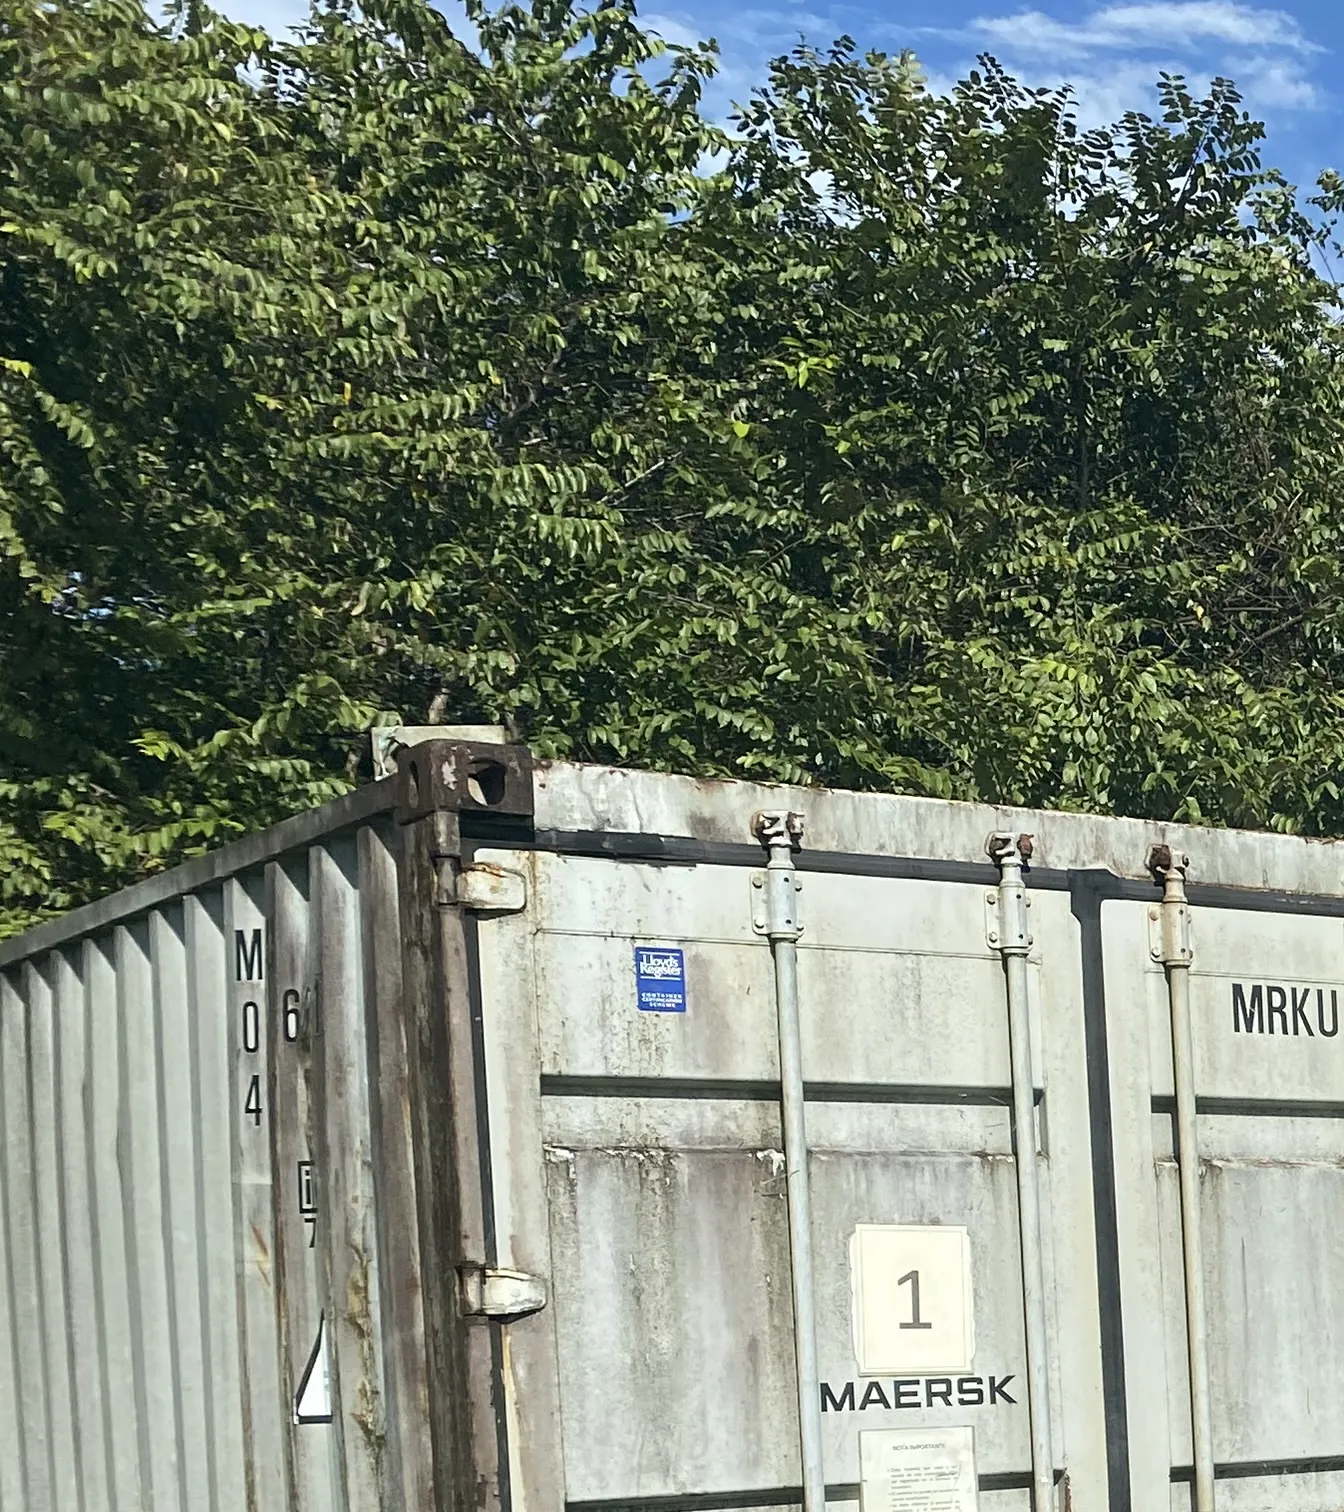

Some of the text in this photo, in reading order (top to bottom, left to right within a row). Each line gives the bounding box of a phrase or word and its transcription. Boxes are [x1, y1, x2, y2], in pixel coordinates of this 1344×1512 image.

[640, 962, 682, 978] Register
[642, 954, 678, 967] Lloyd's
[1231, 983, 1339, 1038] MRKU
[897, 1269, 932, 1330] 1
[820, 1374, 1018, 1413] MAERSK
